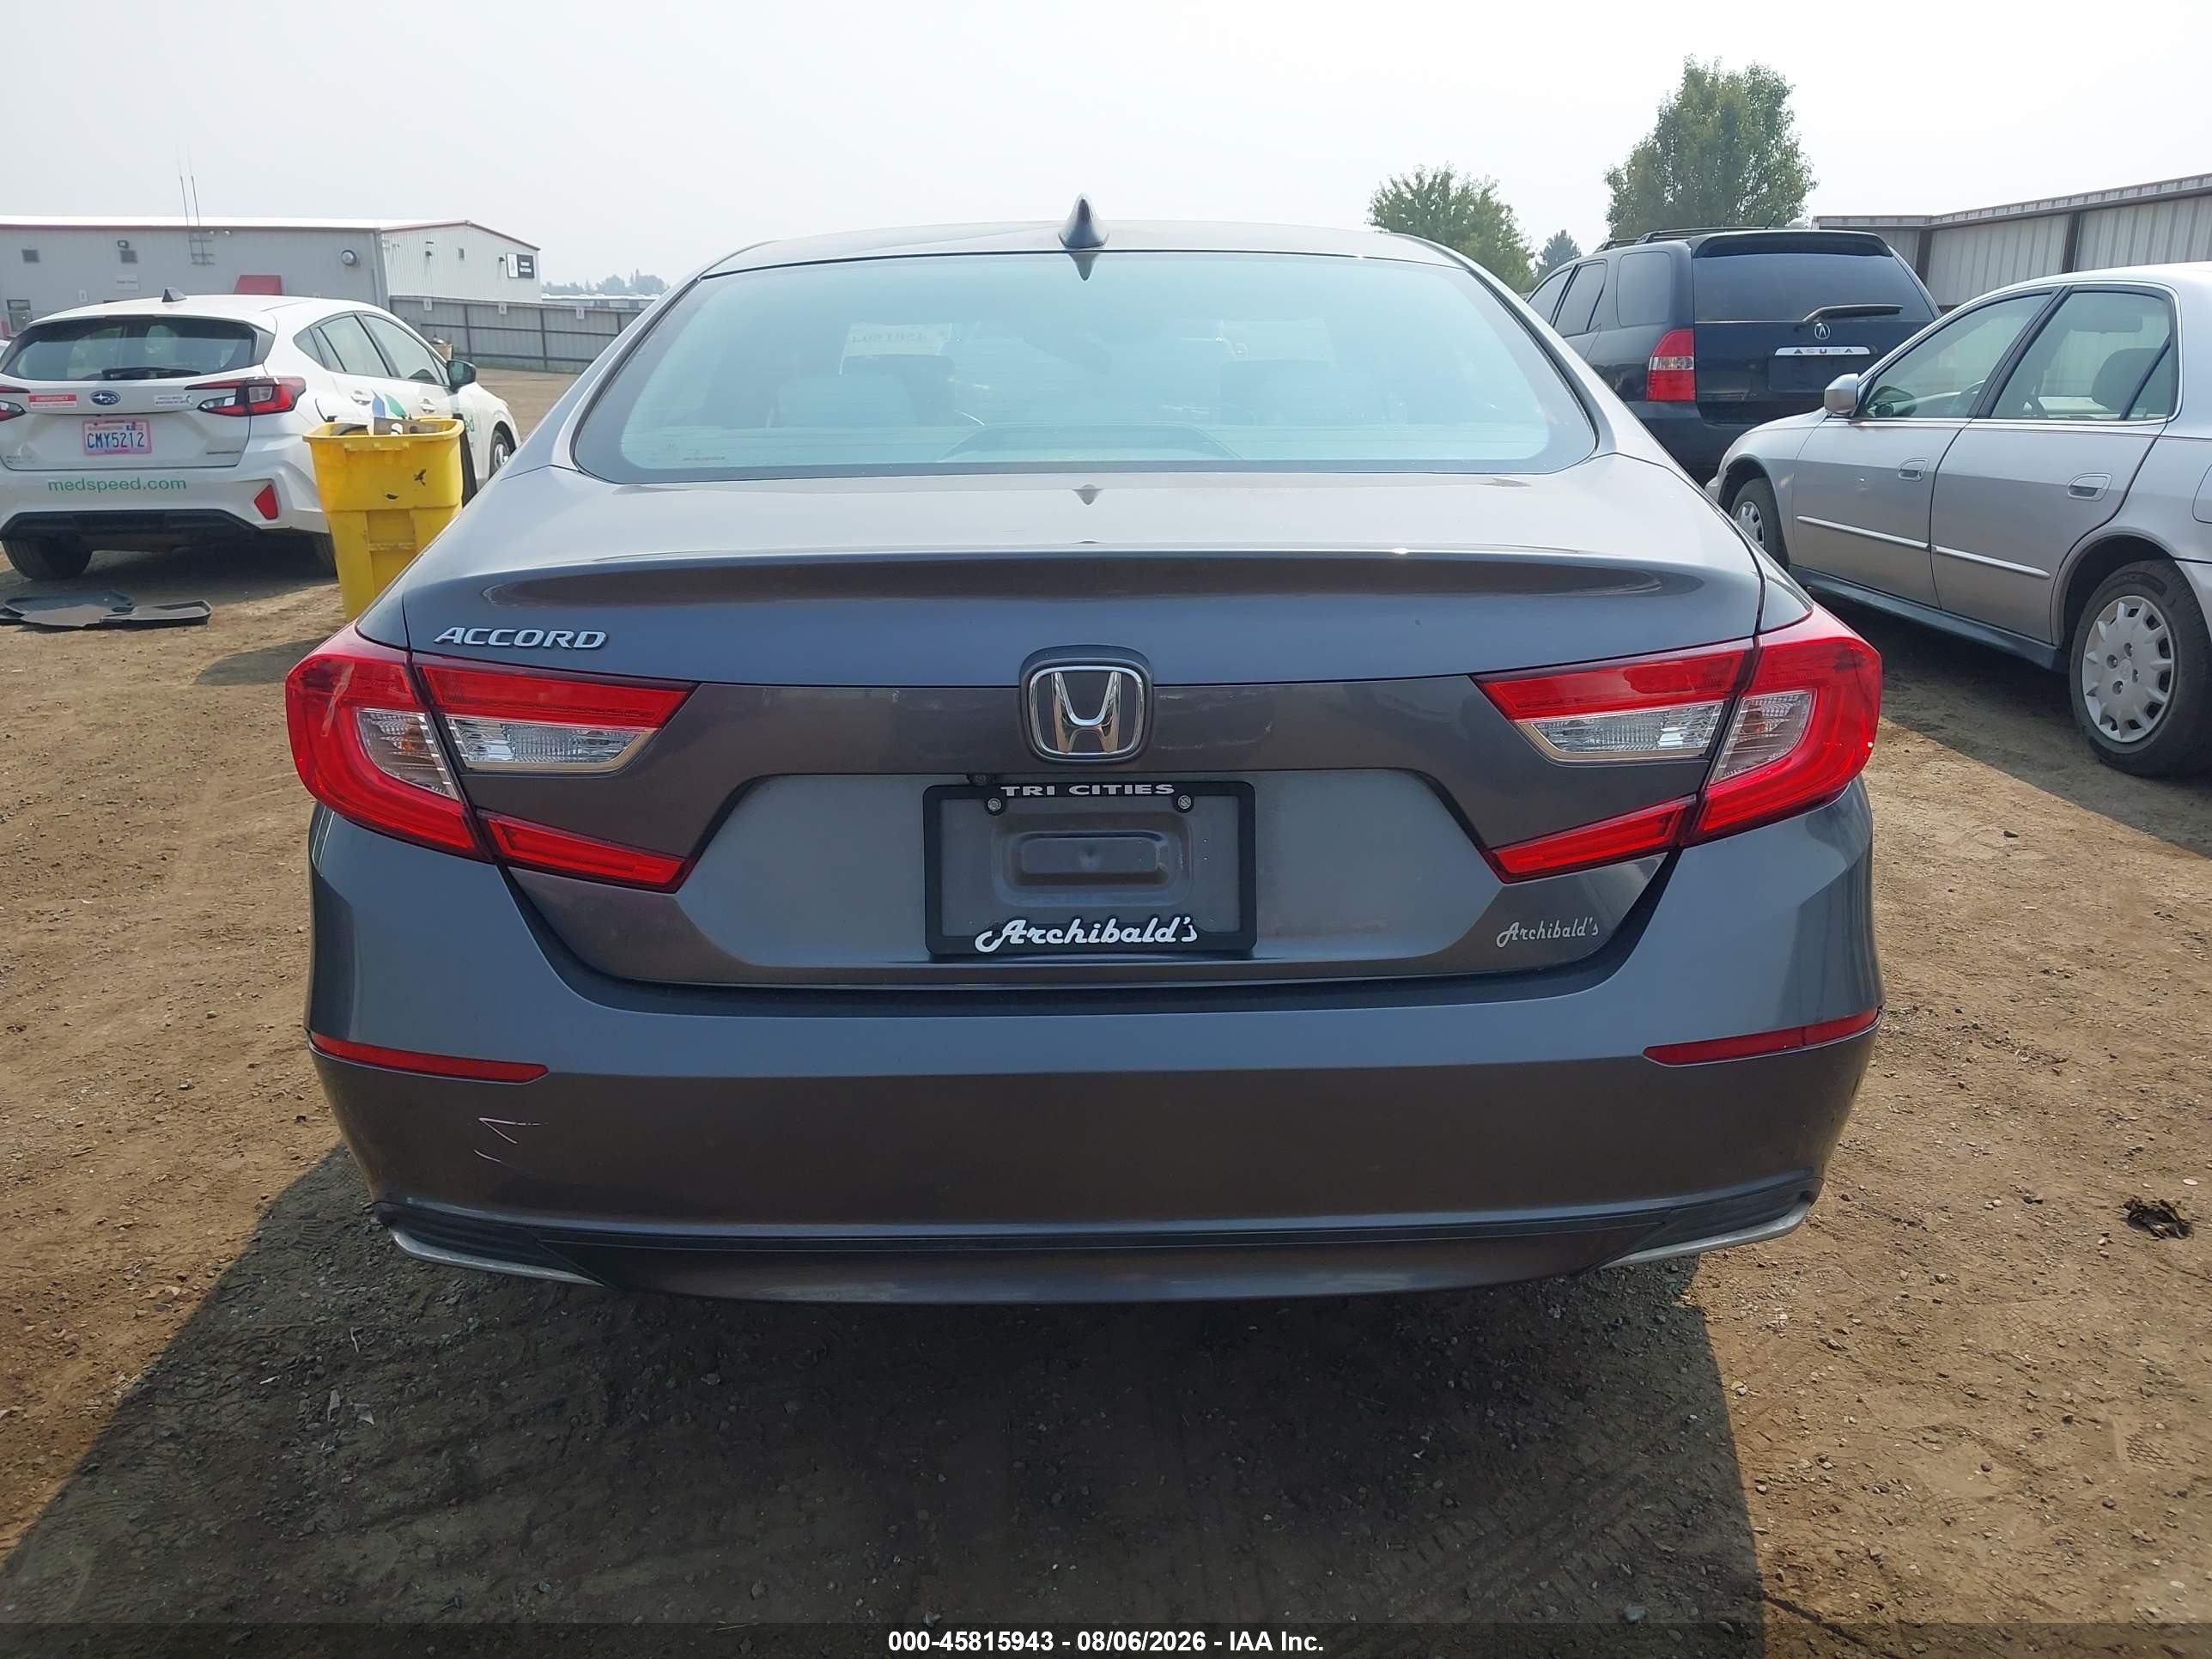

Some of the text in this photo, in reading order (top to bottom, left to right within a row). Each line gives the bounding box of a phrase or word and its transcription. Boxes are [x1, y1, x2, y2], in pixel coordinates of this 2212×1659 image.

[87, 431, 145, 448] CMY5212
[48, 477, 187, 494] medspeed.com
[433, 627, 607, 649] ACCORD
[1000, 783, 1176, 797] TRI CITIES
[975, 916, 1198, 953] Archibald's
[1496, 916, 1599, 948] Archibald's
